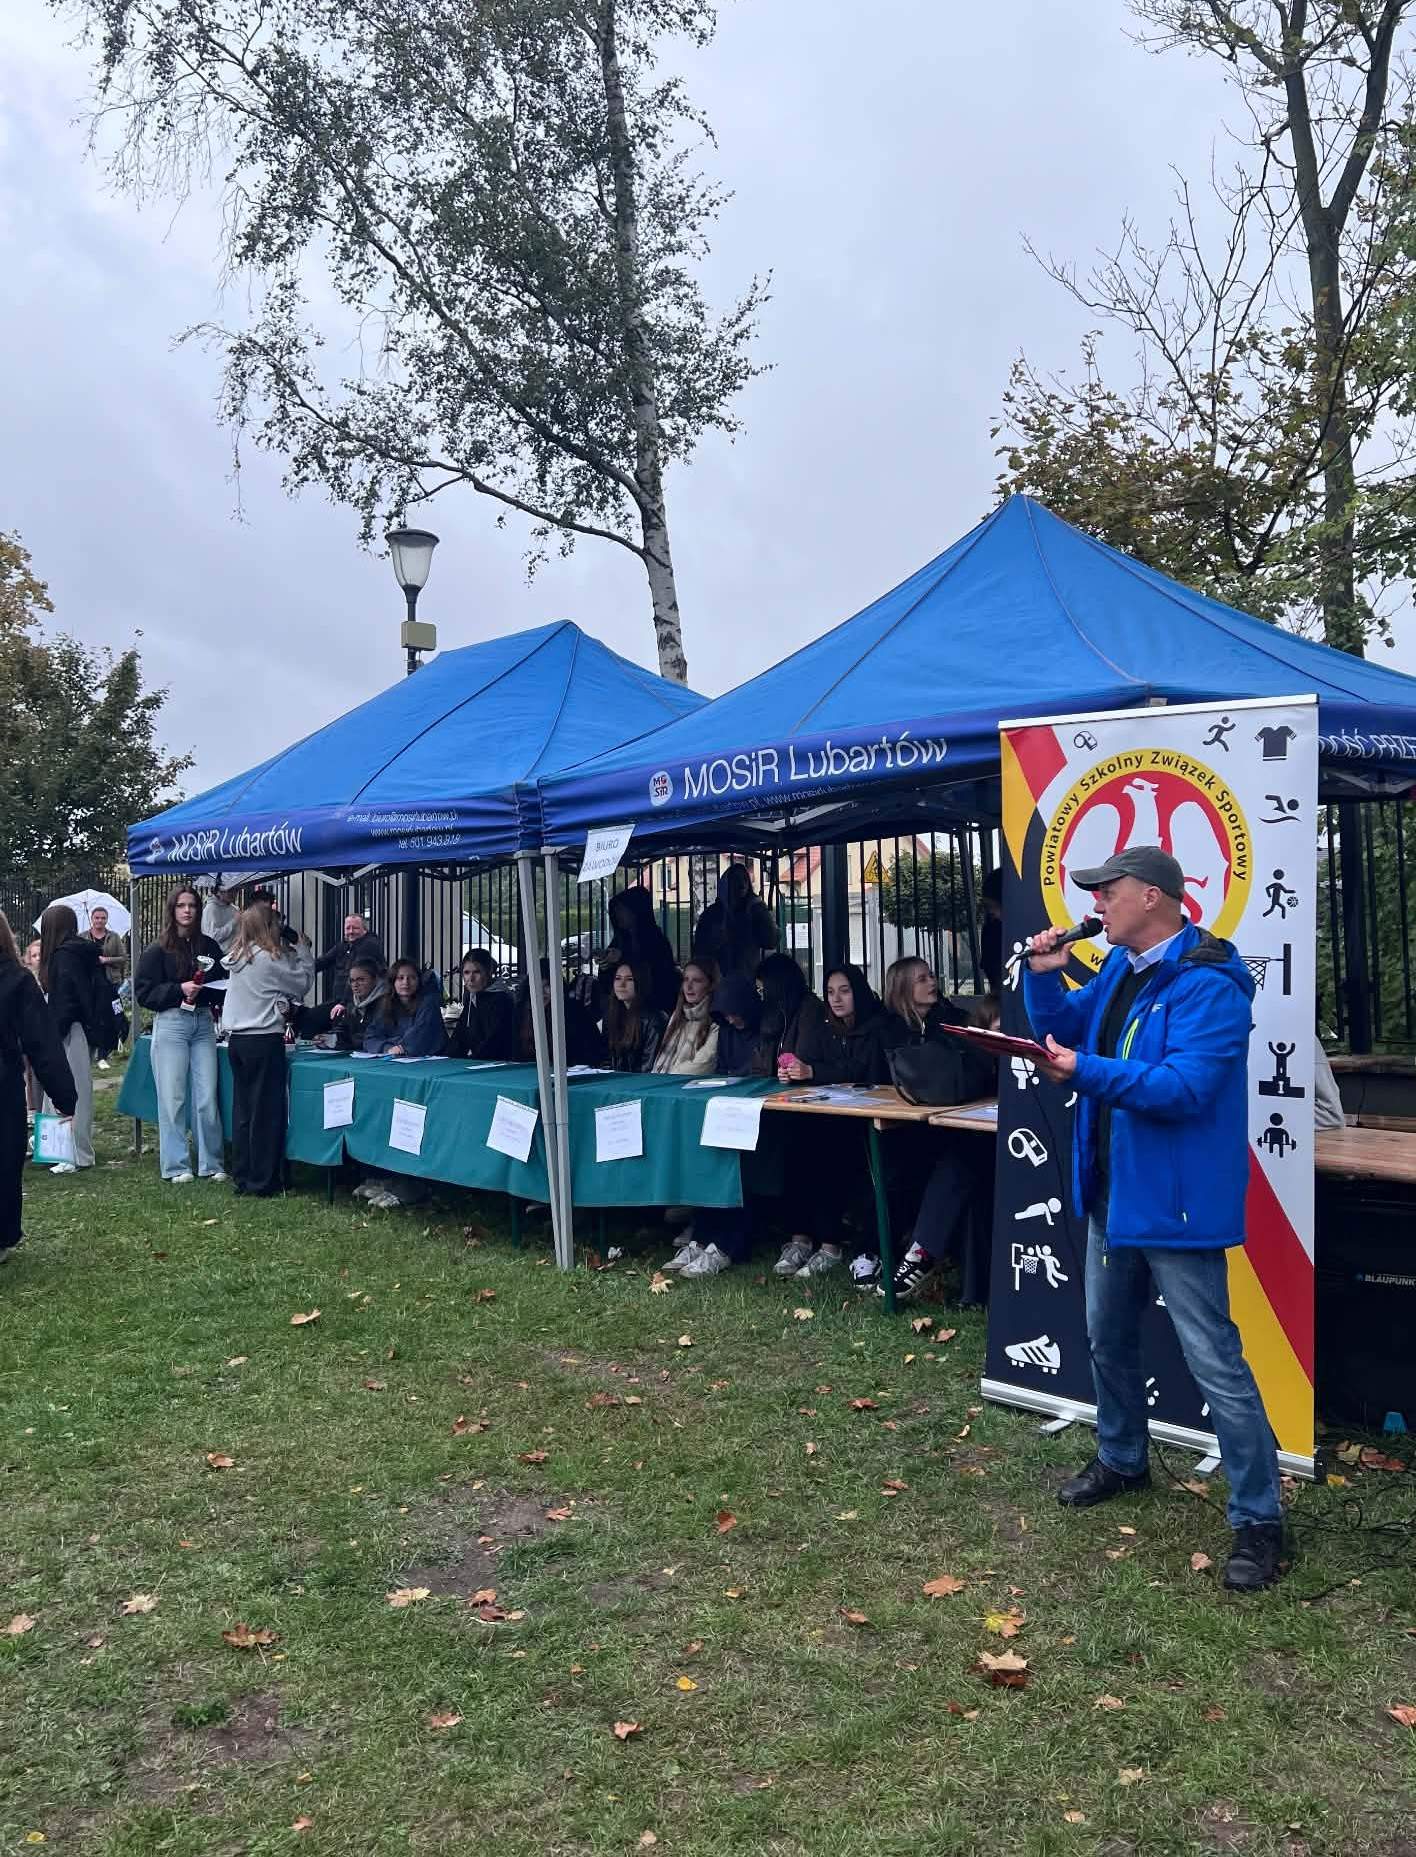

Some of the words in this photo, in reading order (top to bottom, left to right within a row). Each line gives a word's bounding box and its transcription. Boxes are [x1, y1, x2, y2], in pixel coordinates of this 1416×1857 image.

[1318, 728, 1375, 758] DOŚĆ
[683, 747, 780, 800] MOSiR
[789, 731, 948, 781] Lubartów
[1043, 793, 1080, 886] Powiatowy
[1080, 754, 1143, 792] Szkolny
[1150, 751, 1216, 790] Związek
[1215, 790, 1250, 880] Sportowy
[167, 828, 220, 862] MOSiR
[221, 821, 303, 859] Lubartów
[1364, 1273, 1416, 1286] BLAUPUNK
